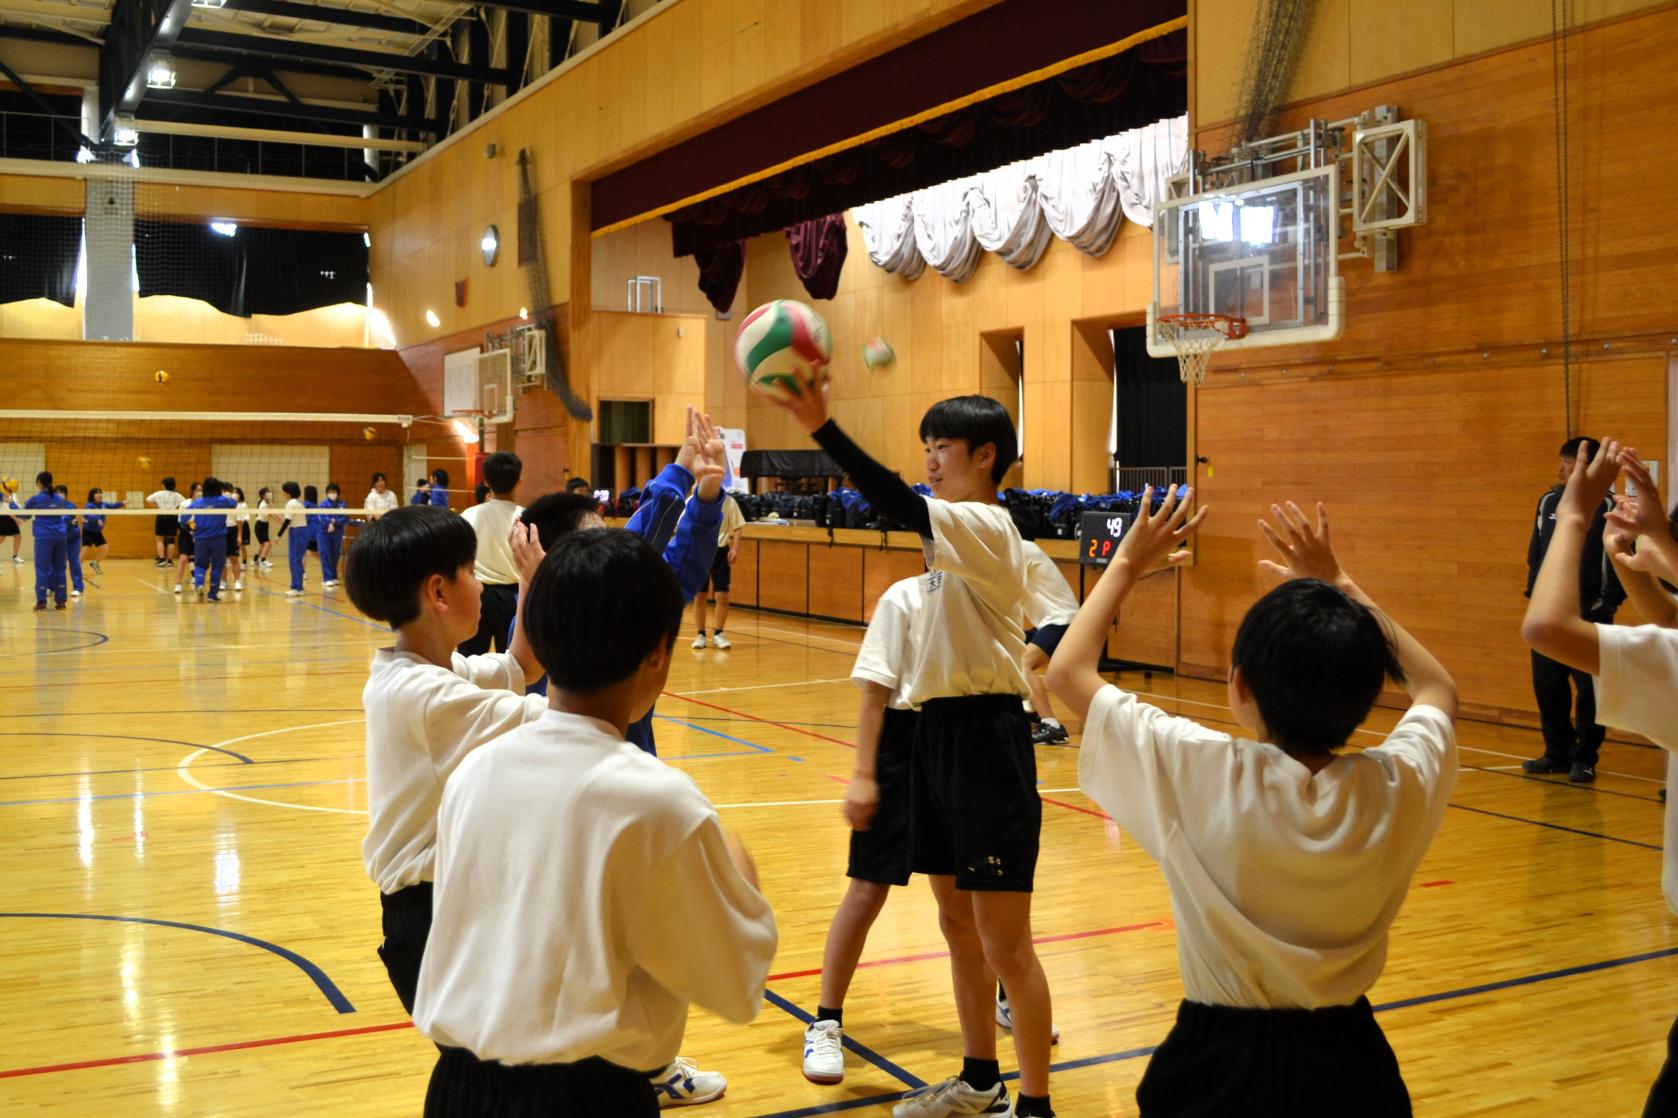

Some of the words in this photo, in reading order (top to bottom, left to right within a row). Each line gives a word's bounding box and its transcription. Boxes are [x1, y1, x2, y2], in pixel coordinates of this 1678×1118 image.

[1106, 517, 1123, 537] 49
[1089, 539, 1098, 558] 2
[1102, 541, 1111, 557] P
